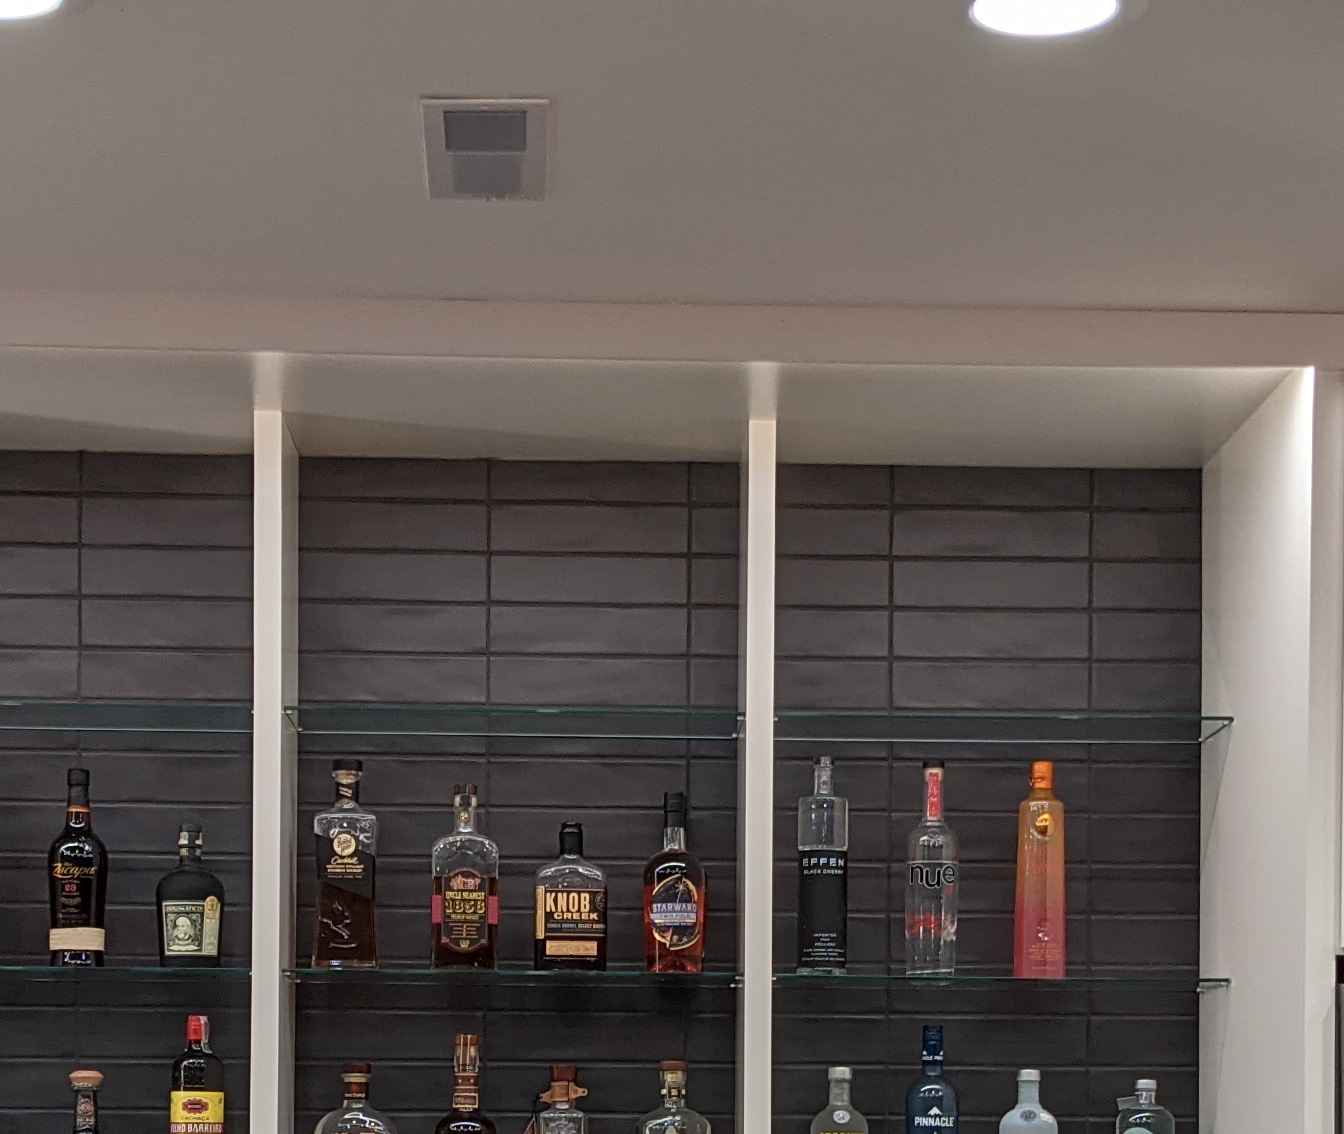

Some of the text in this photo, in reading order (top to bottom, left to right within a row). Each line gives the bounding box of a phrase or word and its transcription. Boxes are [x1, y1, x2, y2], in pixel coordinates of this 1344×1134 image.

[802, 857, 845, 867] EFFEN
[545, 892, 591, 913] KNOB
[652, 903, 697, 913] STARWARD
[553, 912, 599, 921] CREEK
[914, 1116, 955, 1128] PINNACLE
